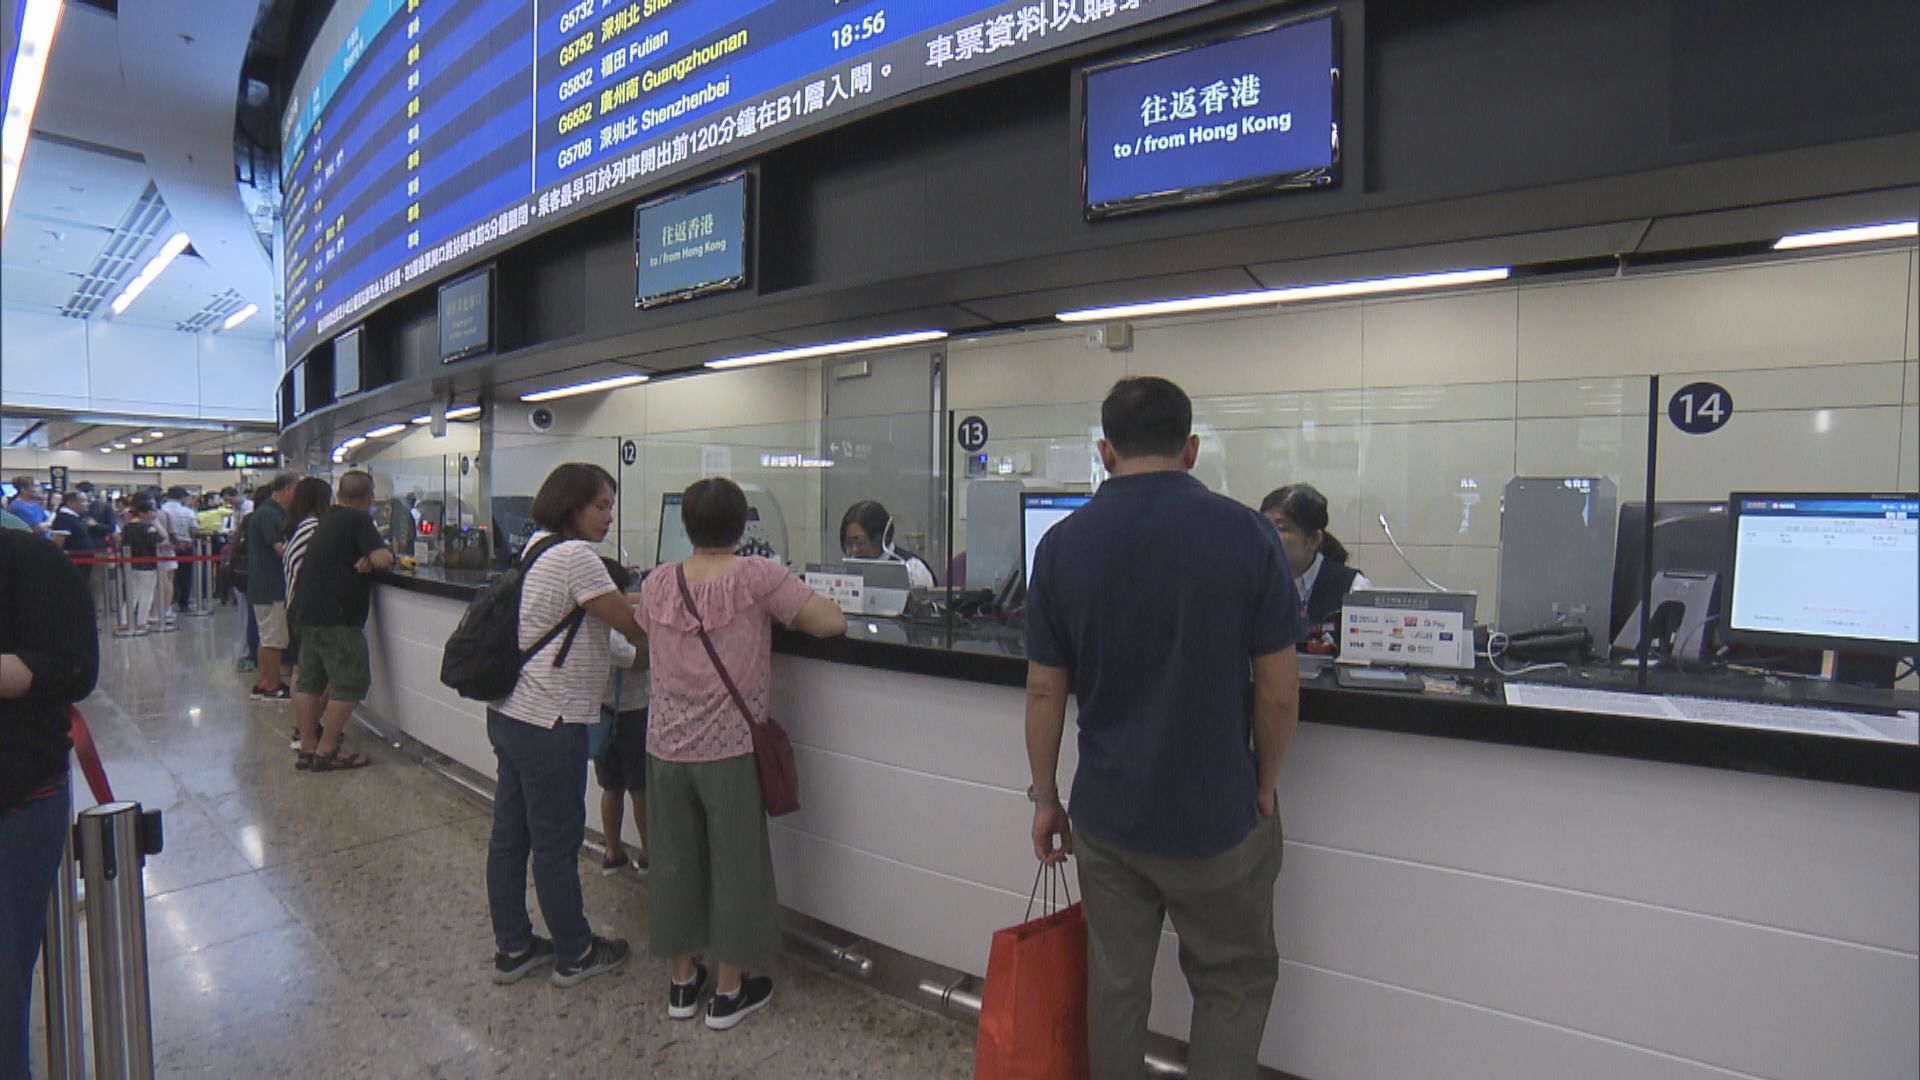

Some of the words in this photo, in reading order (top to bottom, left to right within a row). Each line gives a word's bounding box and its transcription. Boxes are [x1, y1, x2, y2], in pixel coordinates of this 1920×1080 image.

[559, 0, 594, 33] G5732
[559, 32, 594, 67] G5752
[601, 2, 640, 43] 深圳北
[831, 10, 887, 51] 18:56
[925, 0, 1140, 68] 車票資料以購
[558, 102, 593, 135] G6552
[600, 76, 640, 116] 廣州南
[641, 30, 748, 91] Guangzhounan
[558, 67, 593, 101] G5832
[1140, 74, 1261, 127] 往返香港
[557, 138, 592, 169] G5708
[599, 114, 639, 152] 深圳北
[641, 74, 730, 131] Shenzhenbei
[1113, 143, 1132, 159] to
[1144, 131, 1186, 153] from
[1189, 124, 1238, 148] Hong
[1242, 112, 1292, 138] Kong
[662, 213, 714, 247] 往返香港
[682, 244, 704, 259] Hong
[704, 240, 727, 253] Kong
[1679, 392, 1725, 424] 14
[623, 443, 635, 462] 12
[962, 422, 984, 446] 13
